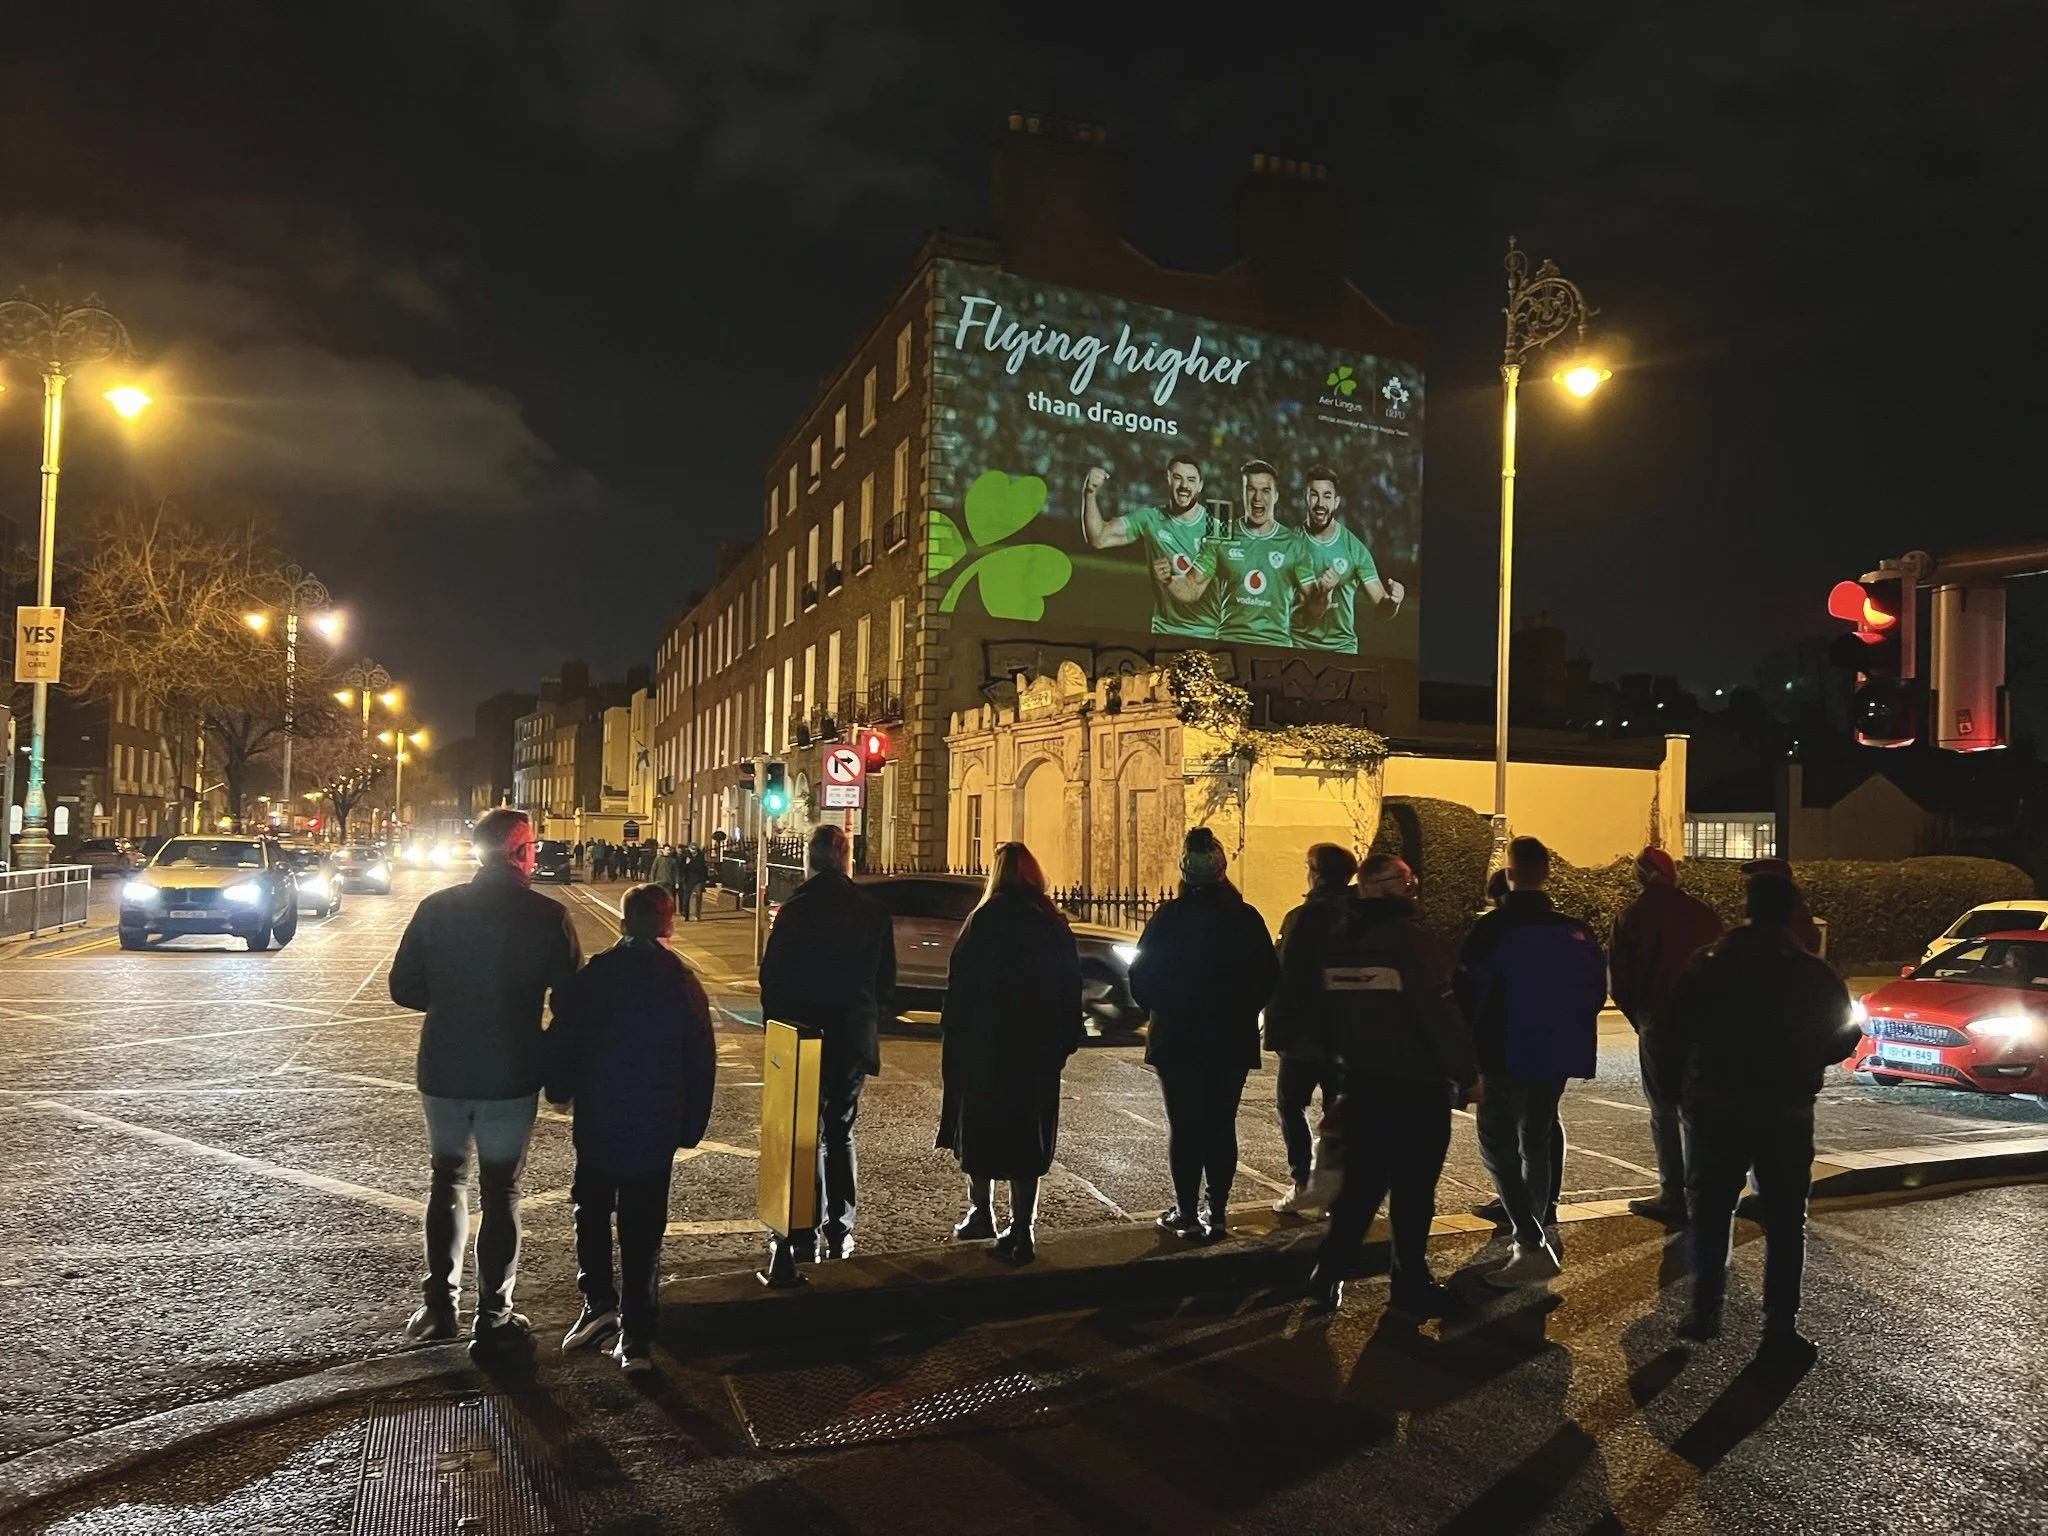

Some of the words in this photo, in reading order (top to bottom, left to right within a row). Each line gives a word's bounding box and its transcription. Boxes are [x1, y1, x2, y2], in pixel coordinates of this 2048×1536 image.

[955, 295, 1110, 396] Flying
[1112, 324, 1250, 406] higher
[1027, 391, 1081, 418] than
[1087, 402, 1178, 436] dragons
[1318, 396, 1334, 405] Aer
[1334, 399, 1363, 413] Lingus
[1235, 596, 1272, 608] vodafone
[23, 626, 56, 644] YES
